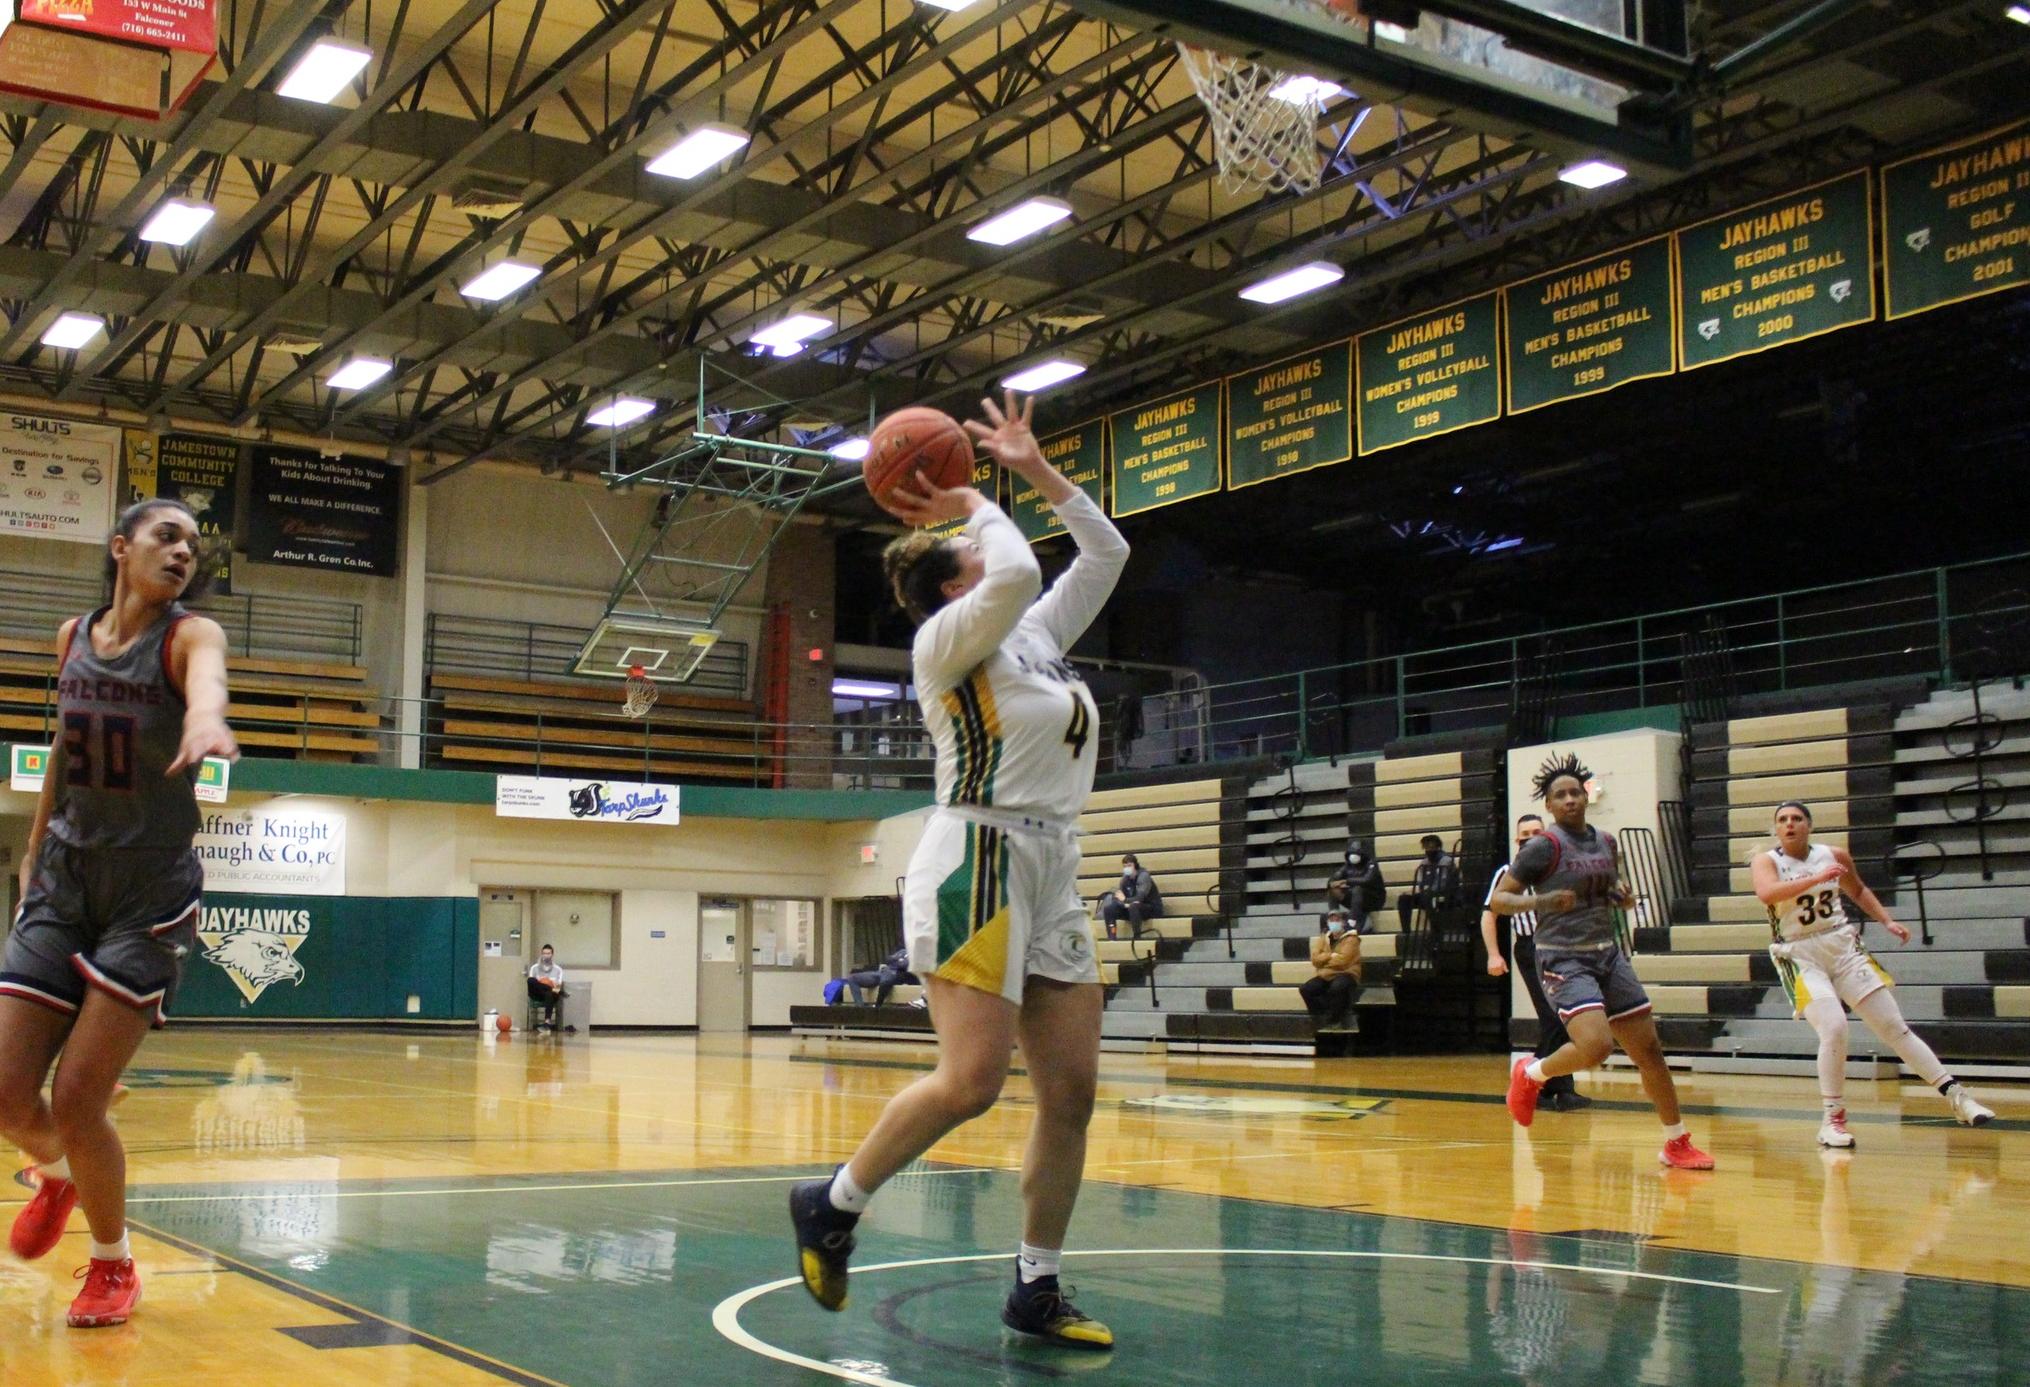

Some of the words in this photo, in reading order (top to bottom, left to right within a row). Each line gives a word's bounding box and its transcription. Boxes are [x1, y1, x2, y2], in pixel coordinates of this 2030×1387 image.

[135, 12, 175, 27] Falconer
[152, 3, 176, 16] Main
[121, 22, 144, 36] (716)
[1930, 135, 2030, 189] JAYHAW
[1948, 178, 2010, 209] REGION
[1719, 198, 1824, 250] JAYHAWKS
[1970, 202, 2015, 230] GOLF
[1734, 242, 1787, 270] REGION
[1944, 226, 2030, 263] CHAMPION
[1540, 259, 1632, 305] JAYHAWKS
[1701, 279, 1743, 304] MEN'S
[1751, 250, 1846, 290] BASKETBALL
[1973, 257, 2014, 282] 2001
[1552, 298, 1599, 324] REGION
[1733, 283, 1815, 319] CHAMPIONS
[1386, 312, 1465, 354] JAYHAWKS
[1525, 332, 1559, 355] MEN'S
[1566, 306, 1651, 343] BASKETBALL
[1758, 314, 1793, 338] 2000
[1398, 348, 1437, 372] REGION
[1551, 337, 1624, 369] CHAMPIONS
[1253, 359, 1322, 395] JAYHAWKS
[1365, 377, 1412, 402] WOMEN'S
[1416, 354, 1490, 386] VOLLEYBALL
[1573, 366, 1605, 386] 1999
[1263, 392, 1297, 412] REGION
[1396, 384, 1458, 414] CHAMPIONS
[11, 416, 71, 435] SHULTS
[1134, 397, 1196, 431] JAYHAWKS
[1236, 418, 1276, 440] WOMEN'S
[1280, 399, 1343, 427] VOLLEYBALL
[162, 439, 236, 458] JAMESTOWN
[1040, 434, 1082, 459] YHAWKS
[1141, 428, 1172, 447] REGION
[1261, 426, 1315, 452] CHAMPIONS
[161, 454, 235, 473] COMMUNITY
[1124, 453, 1149, 470] MEN'S
[1151, 436, 1208, 462] BASKETBALL
[170, 470, 225, 487] COLLEGE
[270, 457, 302, 468] Thanks
[304, 461, 318, 470] for
[320, 463, 352, 476] Talking
[354, 467, 364, 476] To
[366, 469, 385, 479] Your
[281, 470, 301, 479] Kids
[303, 472, 331, 483] About
[1141, 459, 1190, 484] CHAMPIONS
[268, 494, 282, 502] WE
[284, 495, 299, 504] ALL
[301, 497, 324, 508] MAKE
[326, 499, 333, 508] A
[273, 550, 305, 561] Arthur
[307, 552, 317, 561] R.
[1063, 691, 1089, 759] 4
[198, 815, 253, 836] affner
[264, 818, 329, 845] Knight
[194, 841, 252, 867] naugh
[258, 845, 276, 862] &
[317, 850, 336, 865] PC
[217, 872, 251, 880] PUBLIC
[199, 907, 311, 934] JAYHAWKS
[1796, 890, 1834, 926] 33
